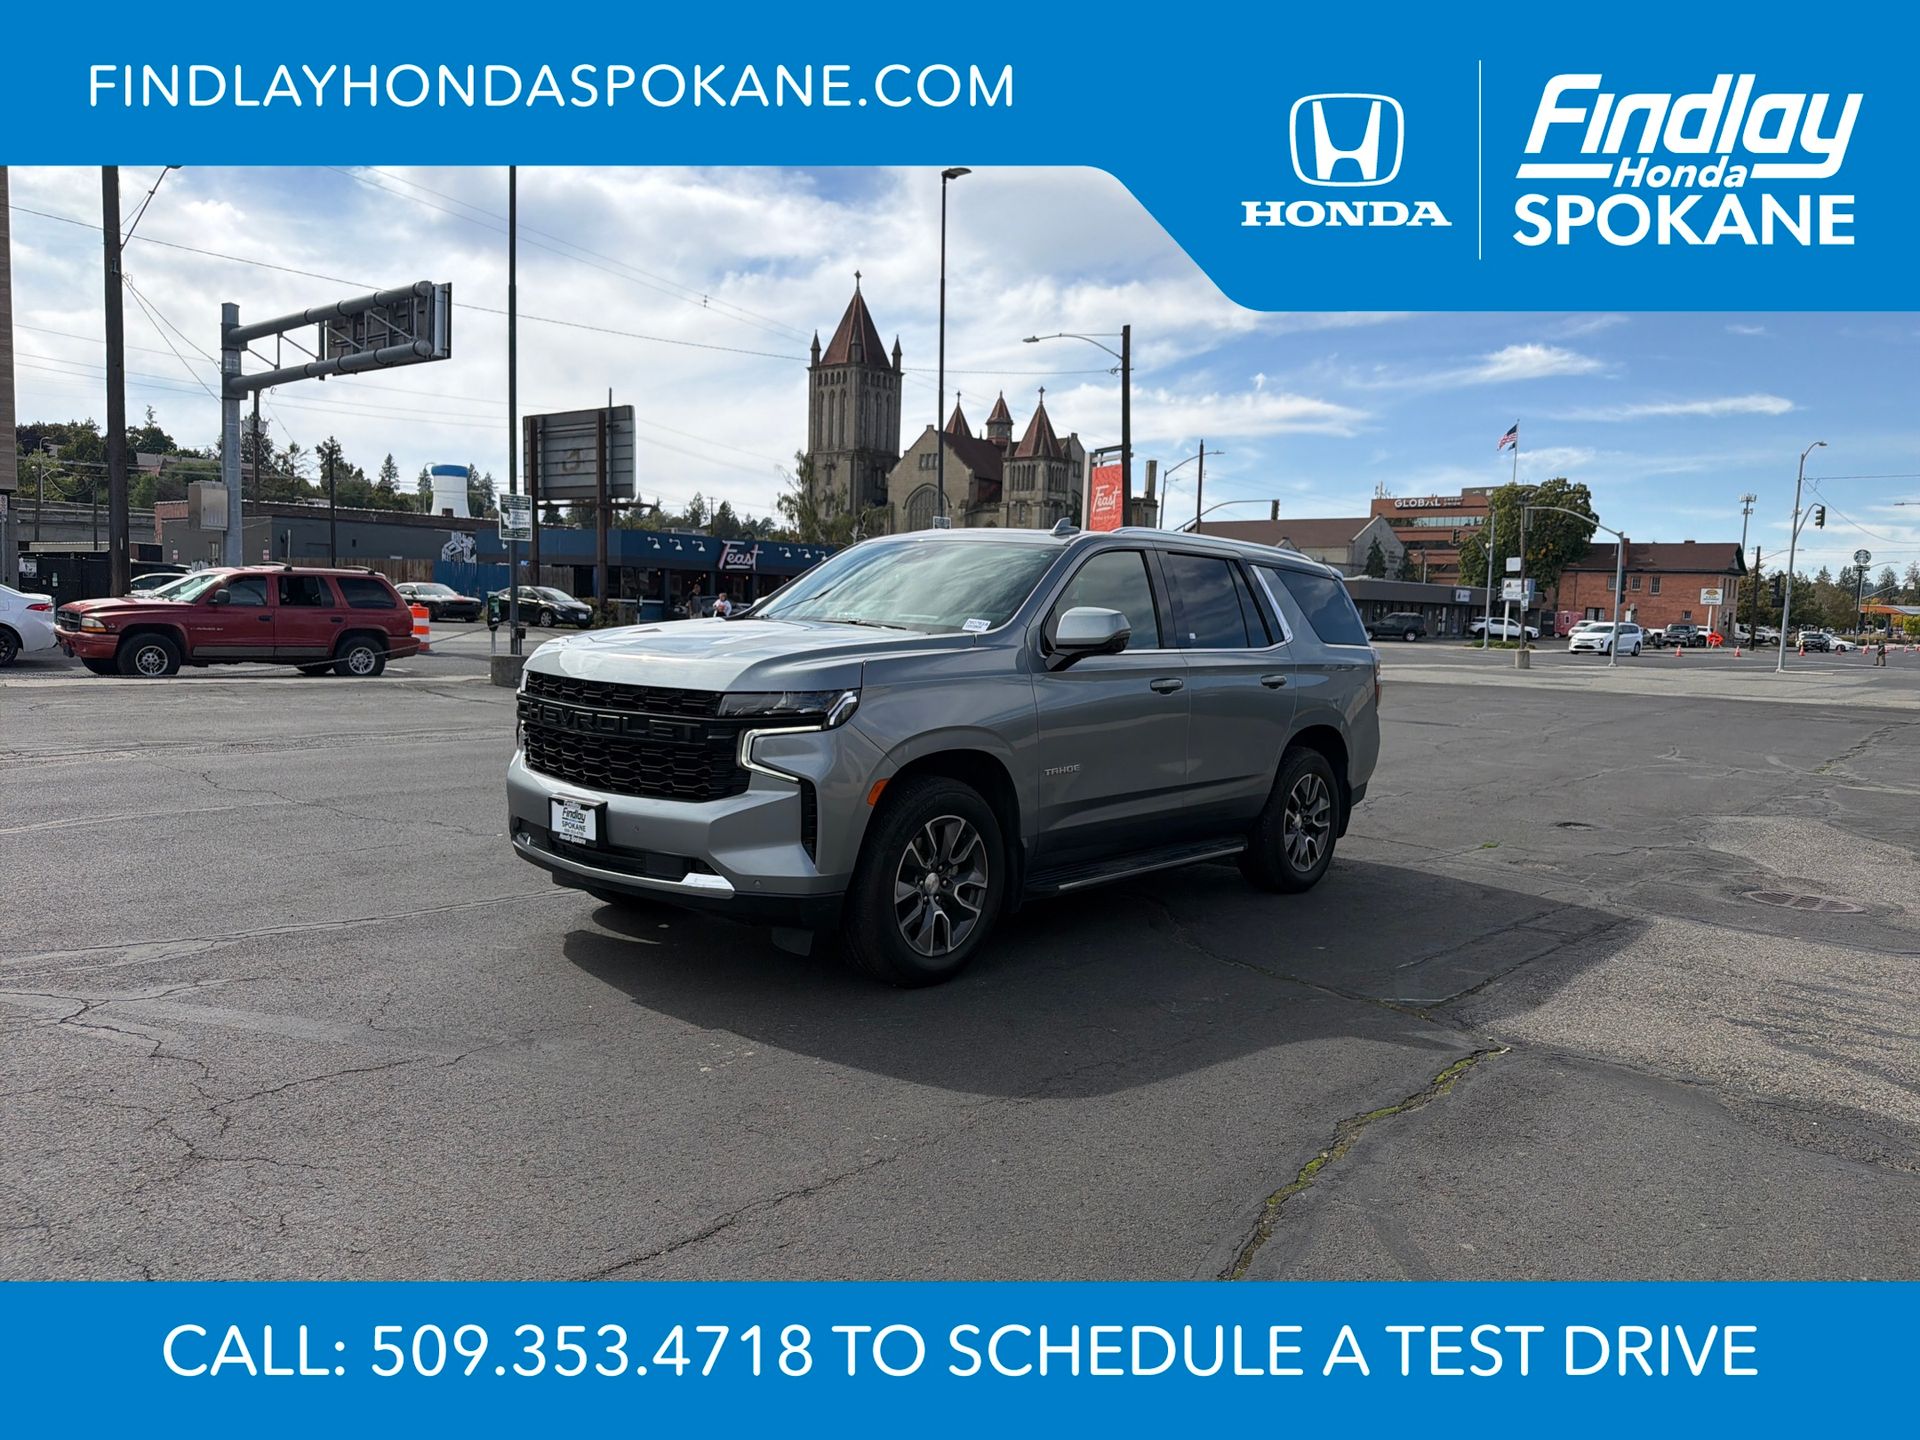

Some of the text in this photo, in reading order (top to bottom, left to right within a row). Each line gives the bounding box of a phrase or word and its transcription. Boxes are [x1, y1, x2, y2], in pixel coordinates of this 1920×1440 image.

[1092, 484, 1121, 512] Feast
[1394, 498, 1441, 508] GLOBAL
[719, 540, 764, 571] Feast
[518, 700, 701, 743] CHEVROLET
[1044, 764, 1080, 776] TAHOE
[562, 807, 587, 824] Findlay
[562, 820, 587, 832] SPOKANE
